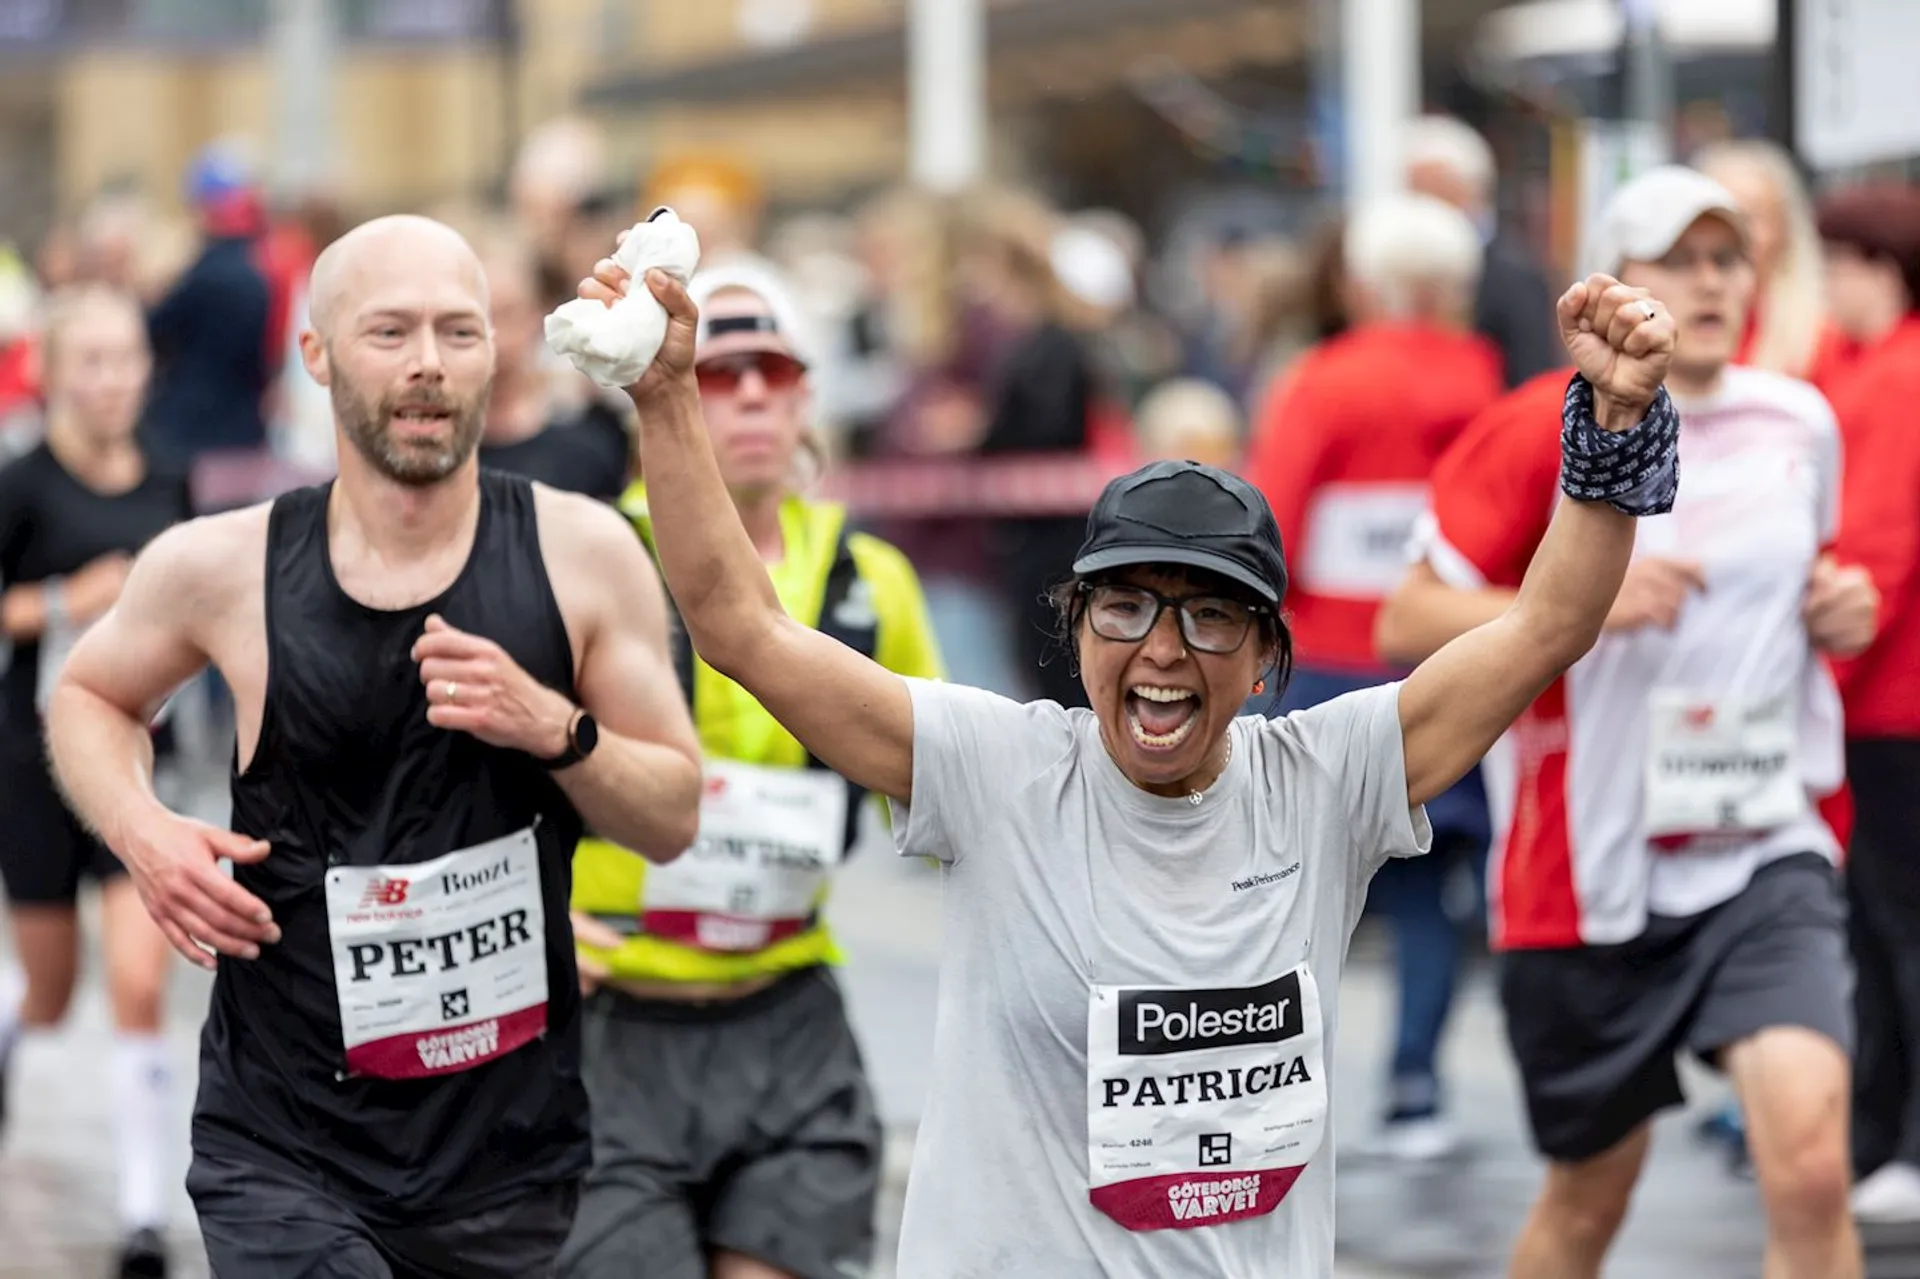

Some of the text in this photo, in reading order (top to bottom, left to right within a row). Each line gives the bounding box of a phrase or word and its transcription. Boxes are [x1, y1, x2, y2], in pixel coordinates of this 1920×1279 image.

[1624, 439, 1644, 456] stc
[1643, 439, 1661, 460] stc
[1618, 459, 1639, 476] stc
[1638, 462, 1659, 482] stc
[1585, 487, 1605, 498] stc
[1611, 479, 1632, 494] stc
[347, 908, 531, 982] PETER
[1136, 998, 1290, 1042] Polestar
[1102, 1056, 1312, 1107] PATRICIA
[1168, 1174, 1260, 1200] GÖTEBORGS
[1169, 1187, 1260, 1220] VARVET
